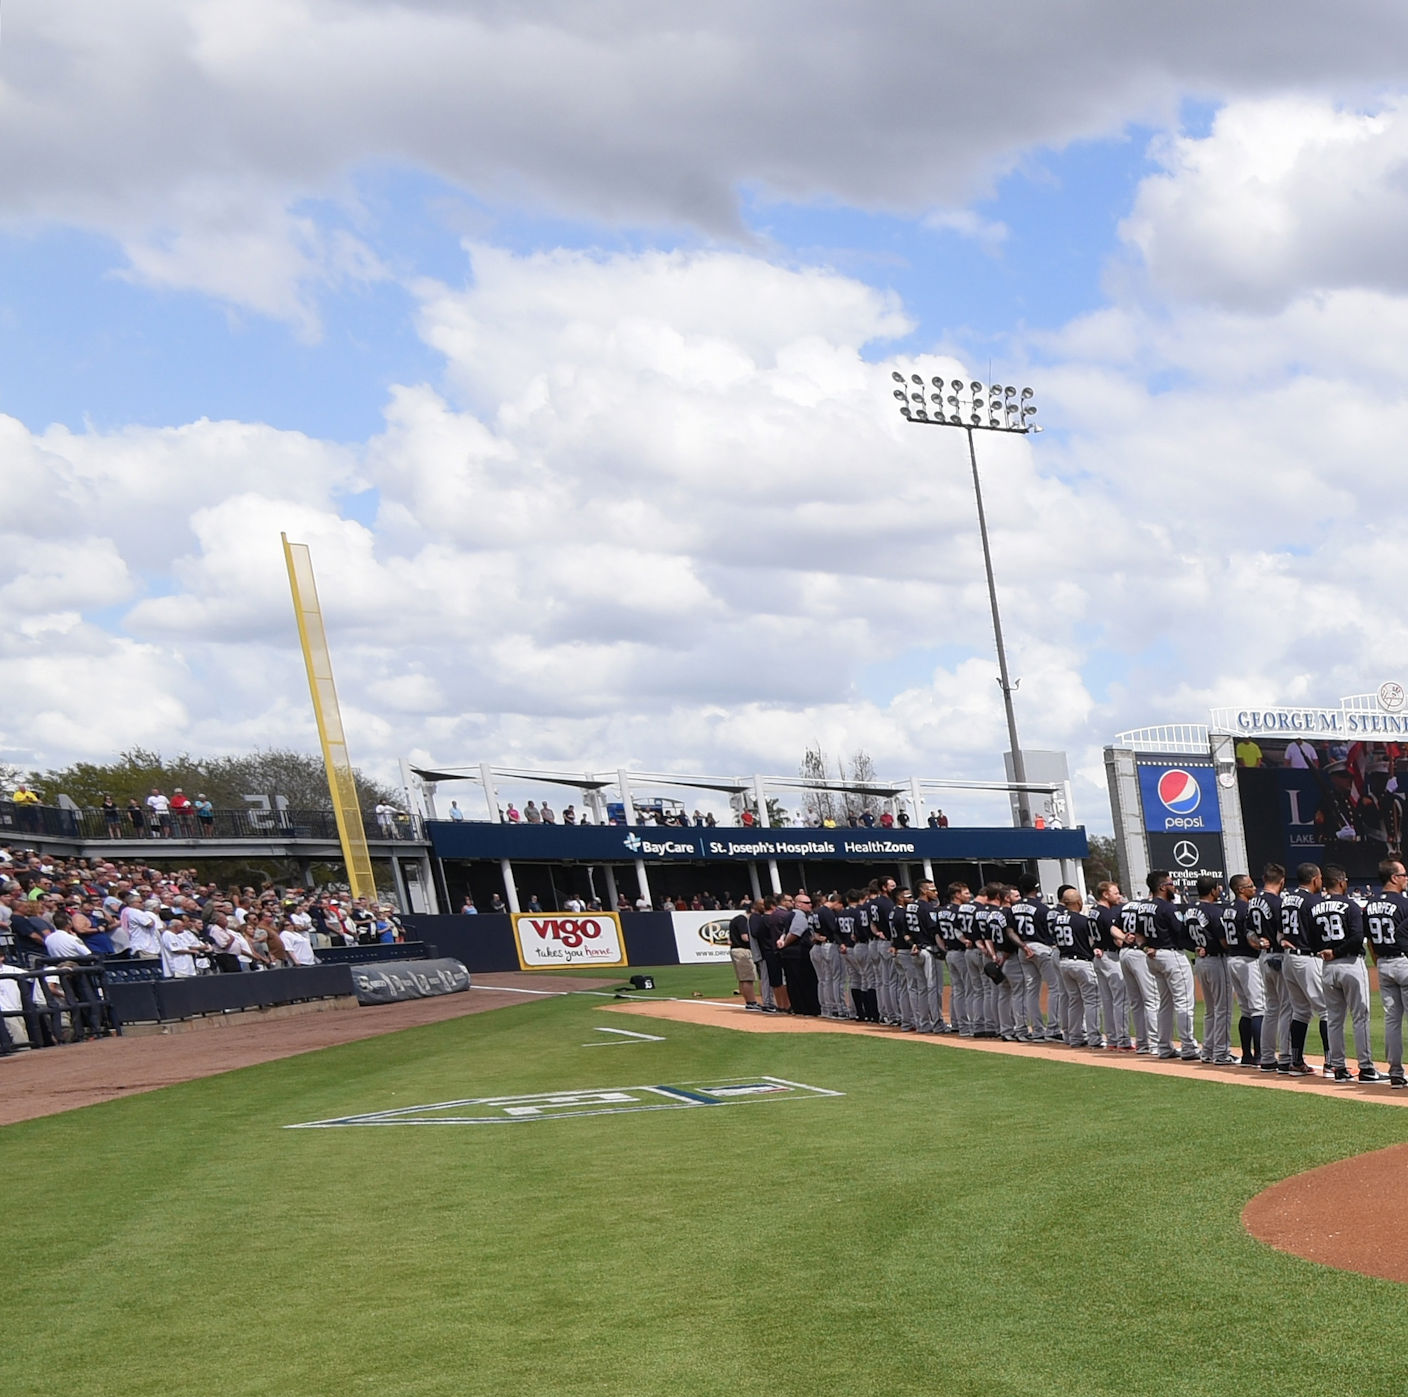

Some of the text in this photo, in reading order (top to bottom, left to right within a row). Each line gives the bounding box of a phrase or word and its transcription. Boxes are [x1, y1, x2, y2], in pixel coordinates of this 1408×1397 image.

[1237, 711, 1315, 730] GEORGE
[1318, 713, 1342, 731] M.
[1165, 816, 1203, 830] pepsi
[642, 840, 915, 856] BayCare St. Joseph's Hospitals HealthZone
[1289, 834, 1315, 844] LAKE
[1310, 900, 1350, 917] MARTINEZ
[1366, 901, 1397, 917] HARPER
[958, 914, 974, 933] 37
[1014, 915, 1035, 936] 76
[1121, 911, 1137, 933] 78
[1138, 915, 1158, 938] 74
[1281, 909, 1299, 935] 24
[1316, 914, 1346, 942] 38
[1368, 917, 1396, 945] 93
[1054, 925, 1074, 946] 28
[1188, 924, 1207, 947] 46
[535, 946, 564, 958] takes
[564, 949, 584, 962] you
